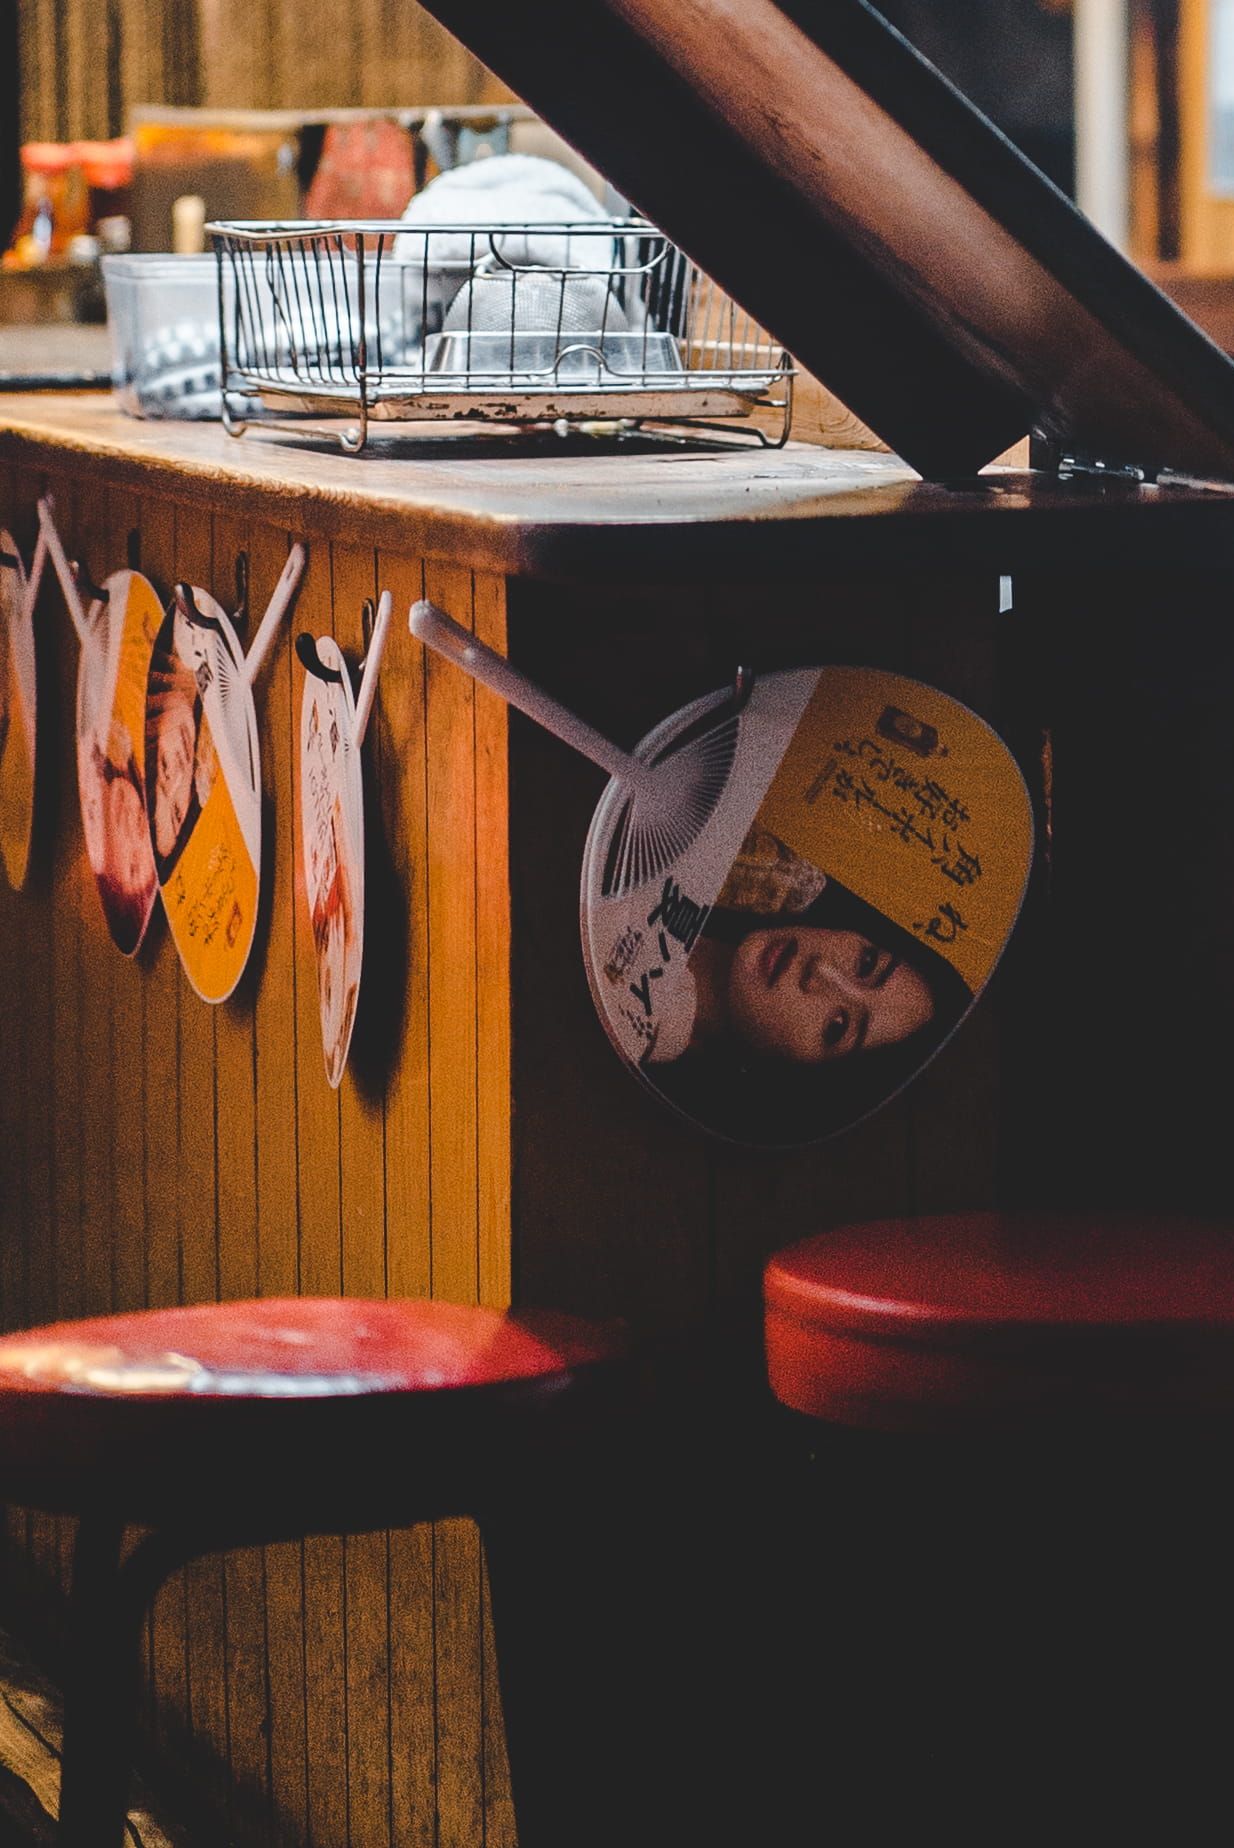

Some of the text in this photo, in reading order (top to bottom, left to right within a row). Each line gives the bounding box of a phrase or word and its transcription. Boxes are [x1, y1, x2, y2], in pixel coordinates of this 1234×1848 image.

[833, 768, 982, 886] 角ハイボールが
